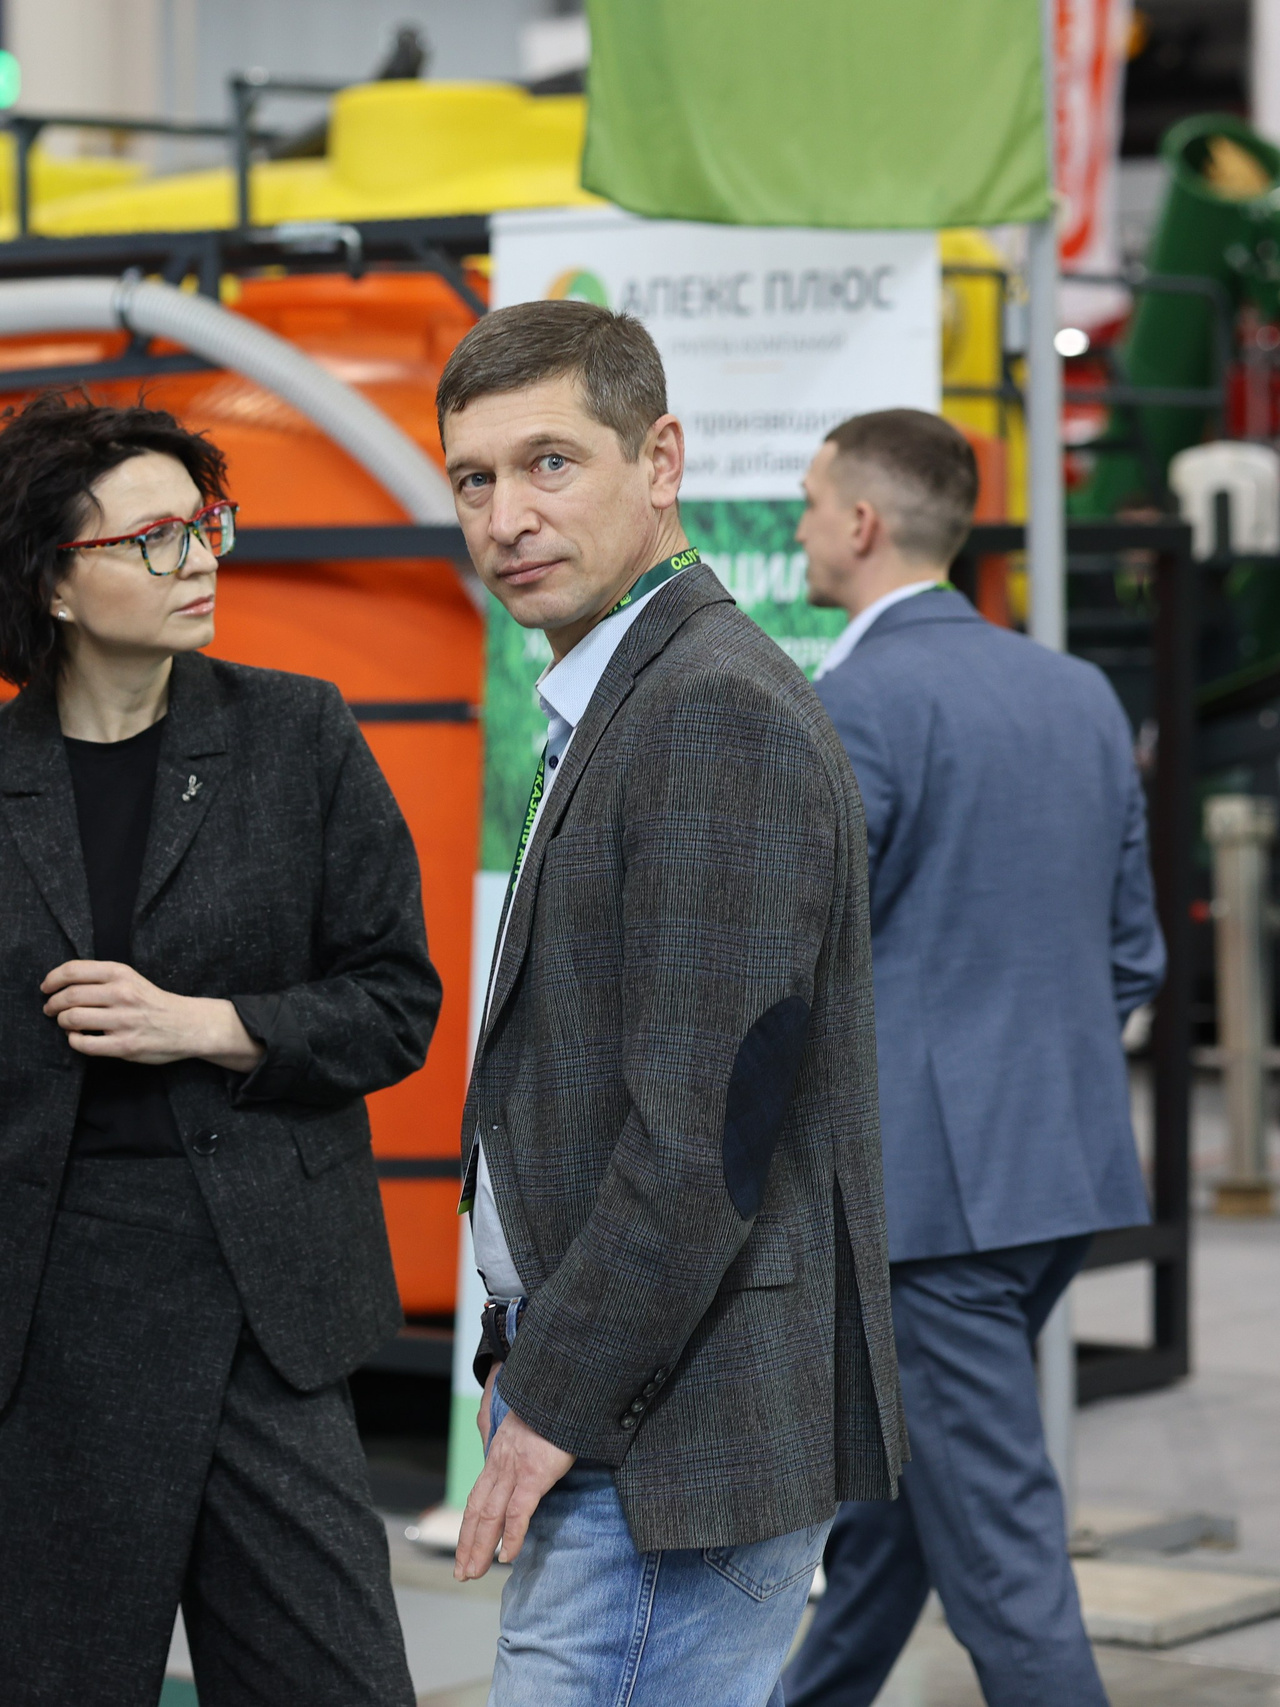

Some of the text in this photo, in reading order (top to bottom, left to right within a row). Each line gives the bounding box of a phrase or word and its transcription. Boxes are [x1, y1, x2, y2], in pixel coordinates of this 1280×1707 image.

[620, 265, 895, 316] АПЕКС ПЛЮС
[670, 549, 697, 571] АГРО
